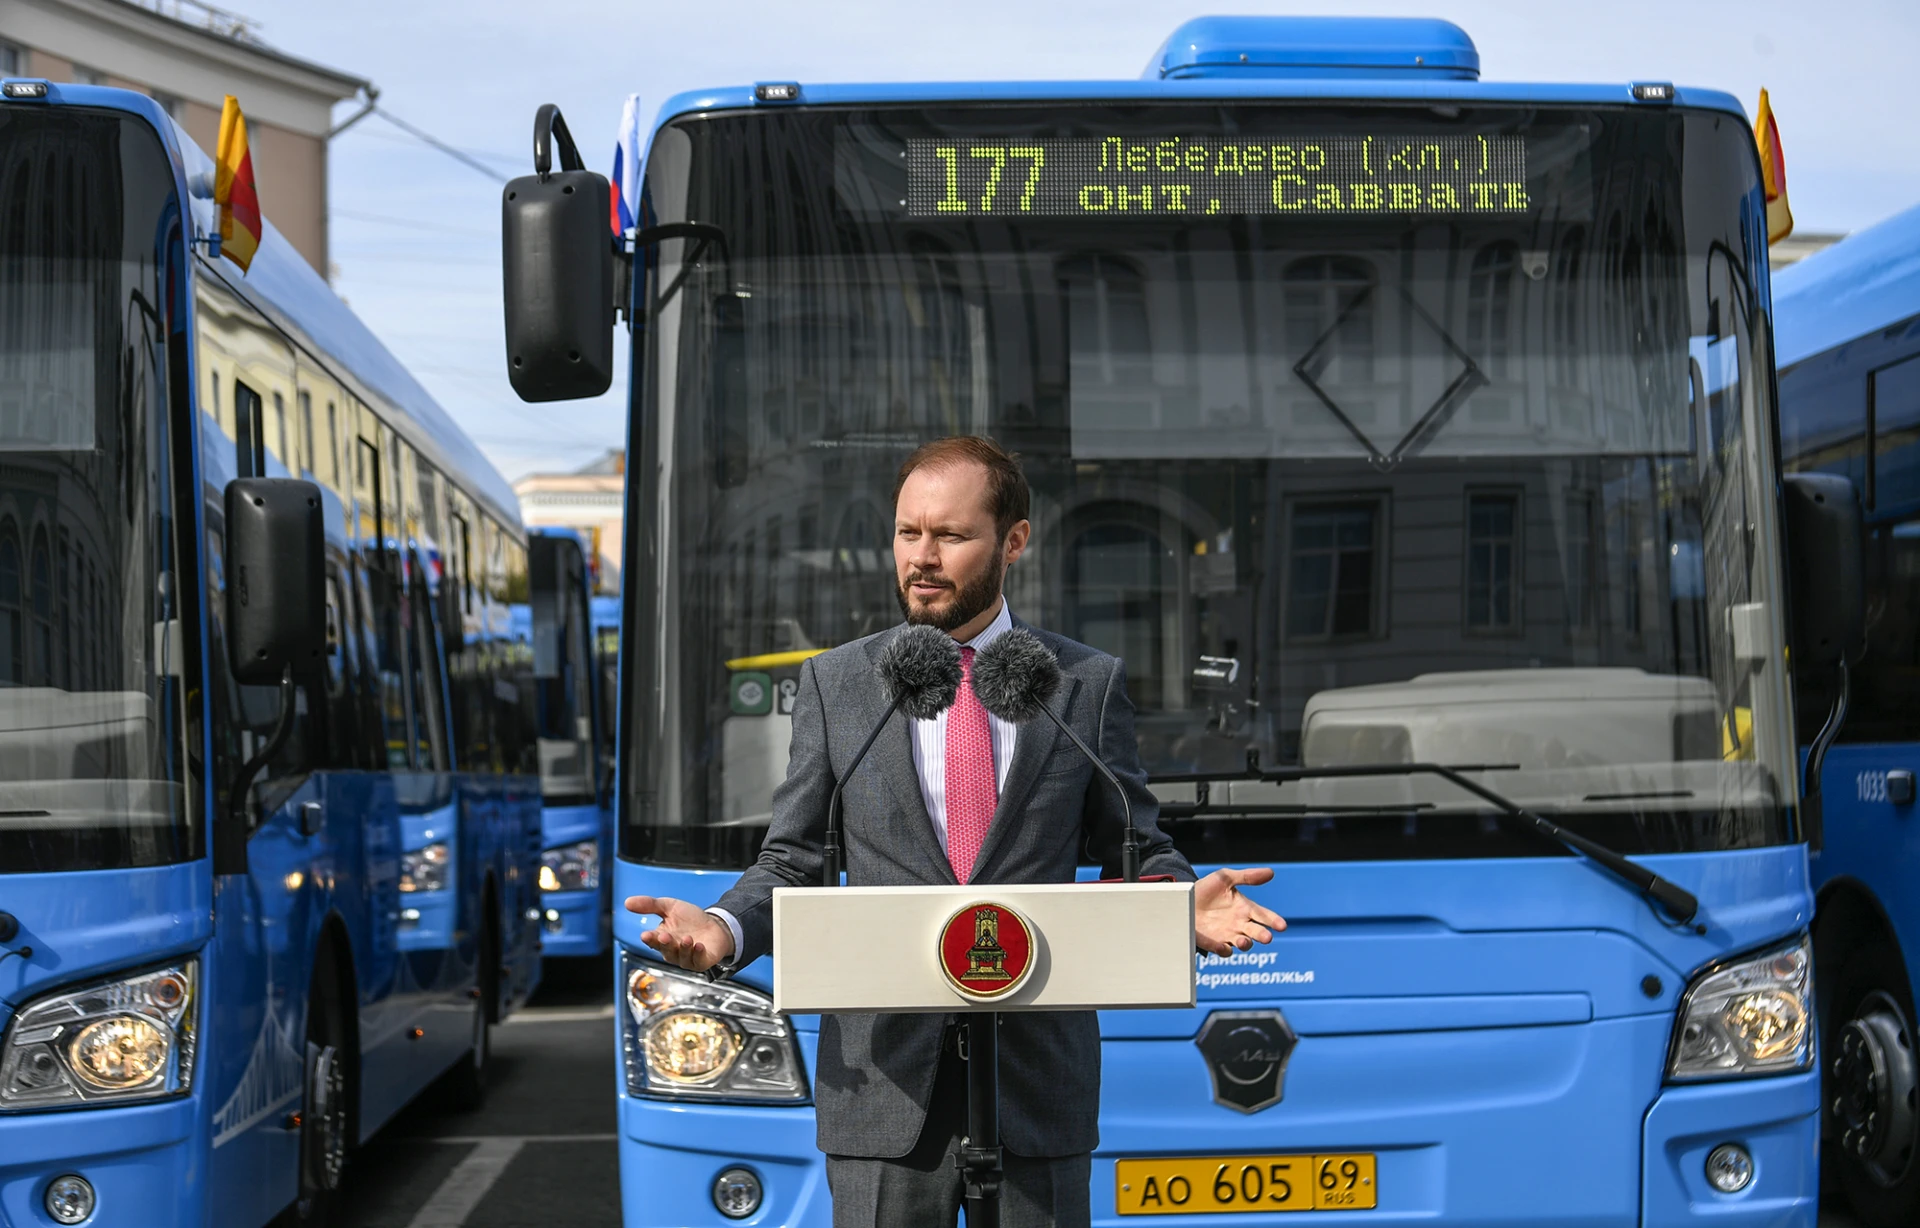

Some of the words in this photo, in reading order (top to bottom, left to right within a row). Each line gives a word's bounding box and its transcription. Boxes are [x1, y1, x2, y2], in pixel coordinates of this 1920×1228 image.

[1098, 136, 1325, 177] Лебедево
[936, 147, 1045, 212] 177
[1079, 185, 1221, 215] онт,
[1856, 770, 1886, 802] 1033
[1140, 1175, 1191, 1207] АО
[1212, 1163, 1292, 1204] 605
[1319, 1158, 1360, 1190] 69
[1323, 1191, 1356, 1205] RUS
